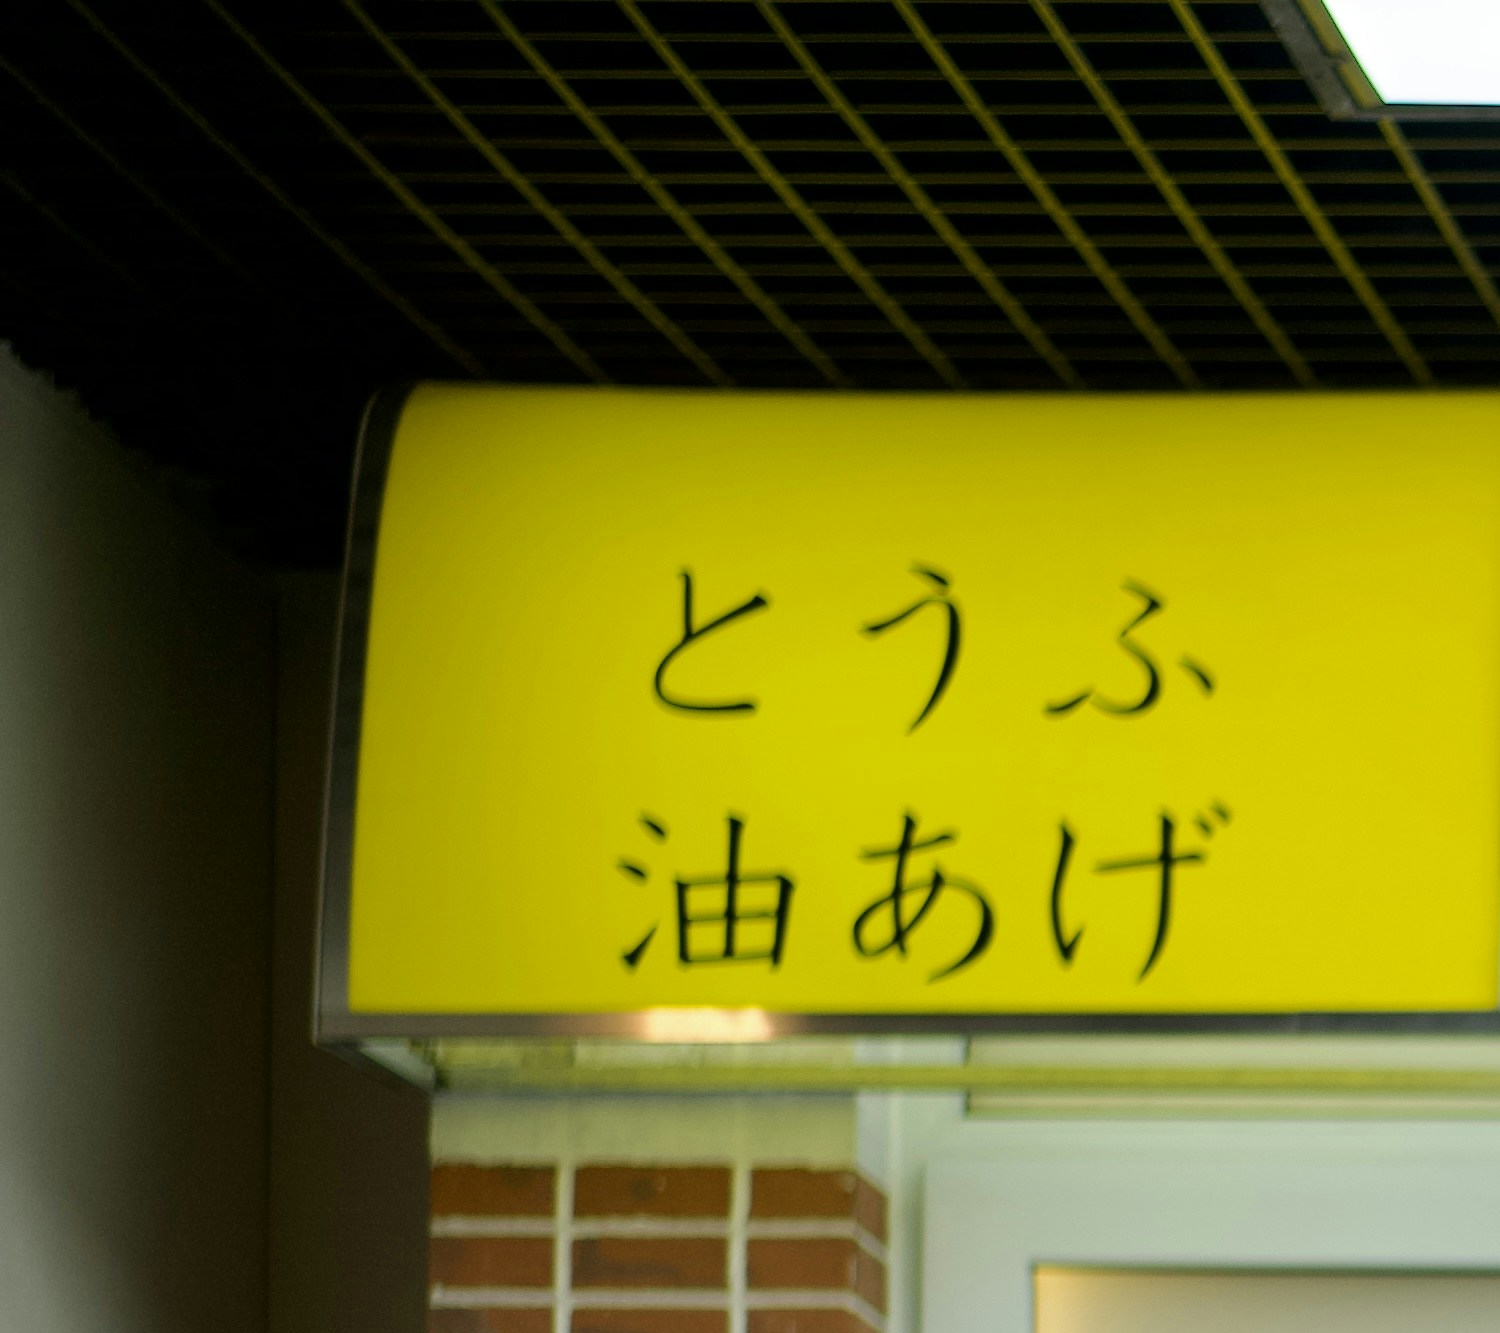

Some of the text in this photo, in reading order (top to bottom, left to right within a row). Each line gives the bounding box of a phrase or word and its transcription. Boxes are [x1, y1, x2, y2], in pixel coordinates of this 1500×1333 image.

[650, 563, 1216, 732] とうふ
[616, 803, 1232, 982] 油あげ
